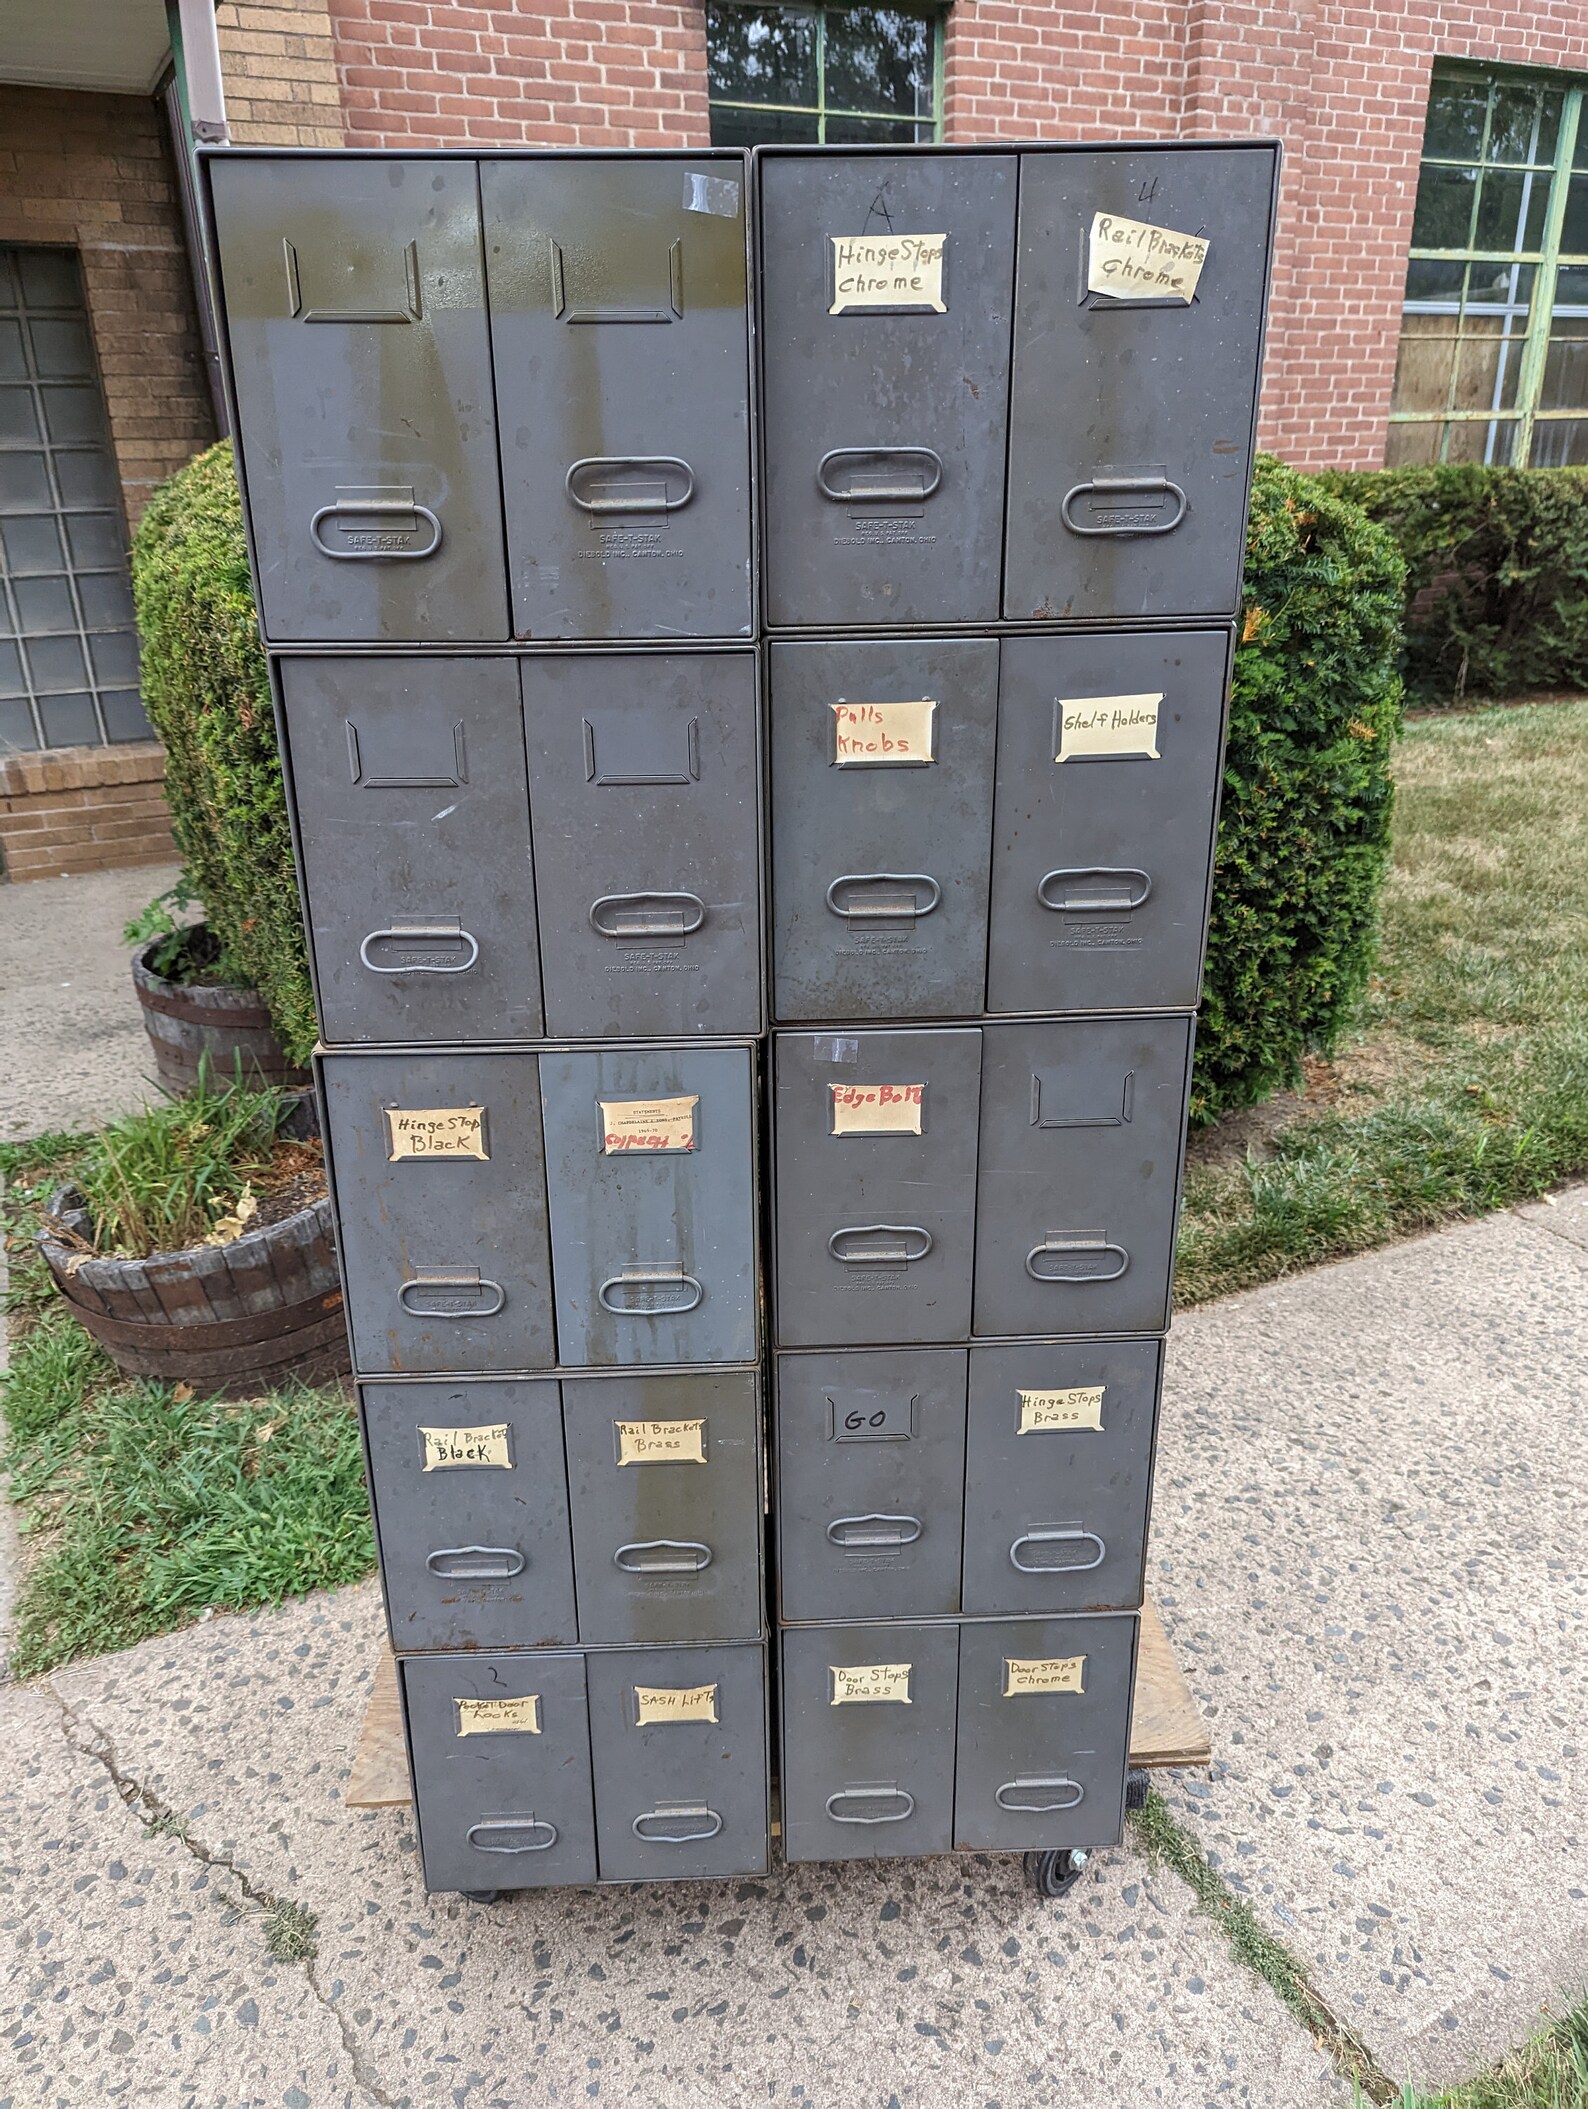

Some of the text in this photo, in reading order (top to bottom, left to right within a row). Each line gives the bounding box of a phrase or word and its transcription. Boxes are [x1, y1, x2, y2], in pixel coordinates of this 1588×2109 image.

[1063, 709, 1157, 730] Shelf Holders
[837, 732, 909, 753] Knobs
[833, 1086, 876, 1109] Edge
[398, 1118, 446, 1134] Hinge
[409, 1134, 471, 1153] Black
[1022, 1394, 1065, 1410] Hinge
[1033, 1411, 1080, 1425] Brass
[620, 1423, 646, 1436] Rail
[423, 1430, 458, 1447] Rail
[634, 1438, 681, 1453] Brass
[436, 1444, 491, 1463] Black
[1011, 1662, 1039, 1674] Door
[838, 1670, 865, 1684] Door
[844, 1683, 892, 1696] Brass
[640, 1694, 676, 1706] SASH
